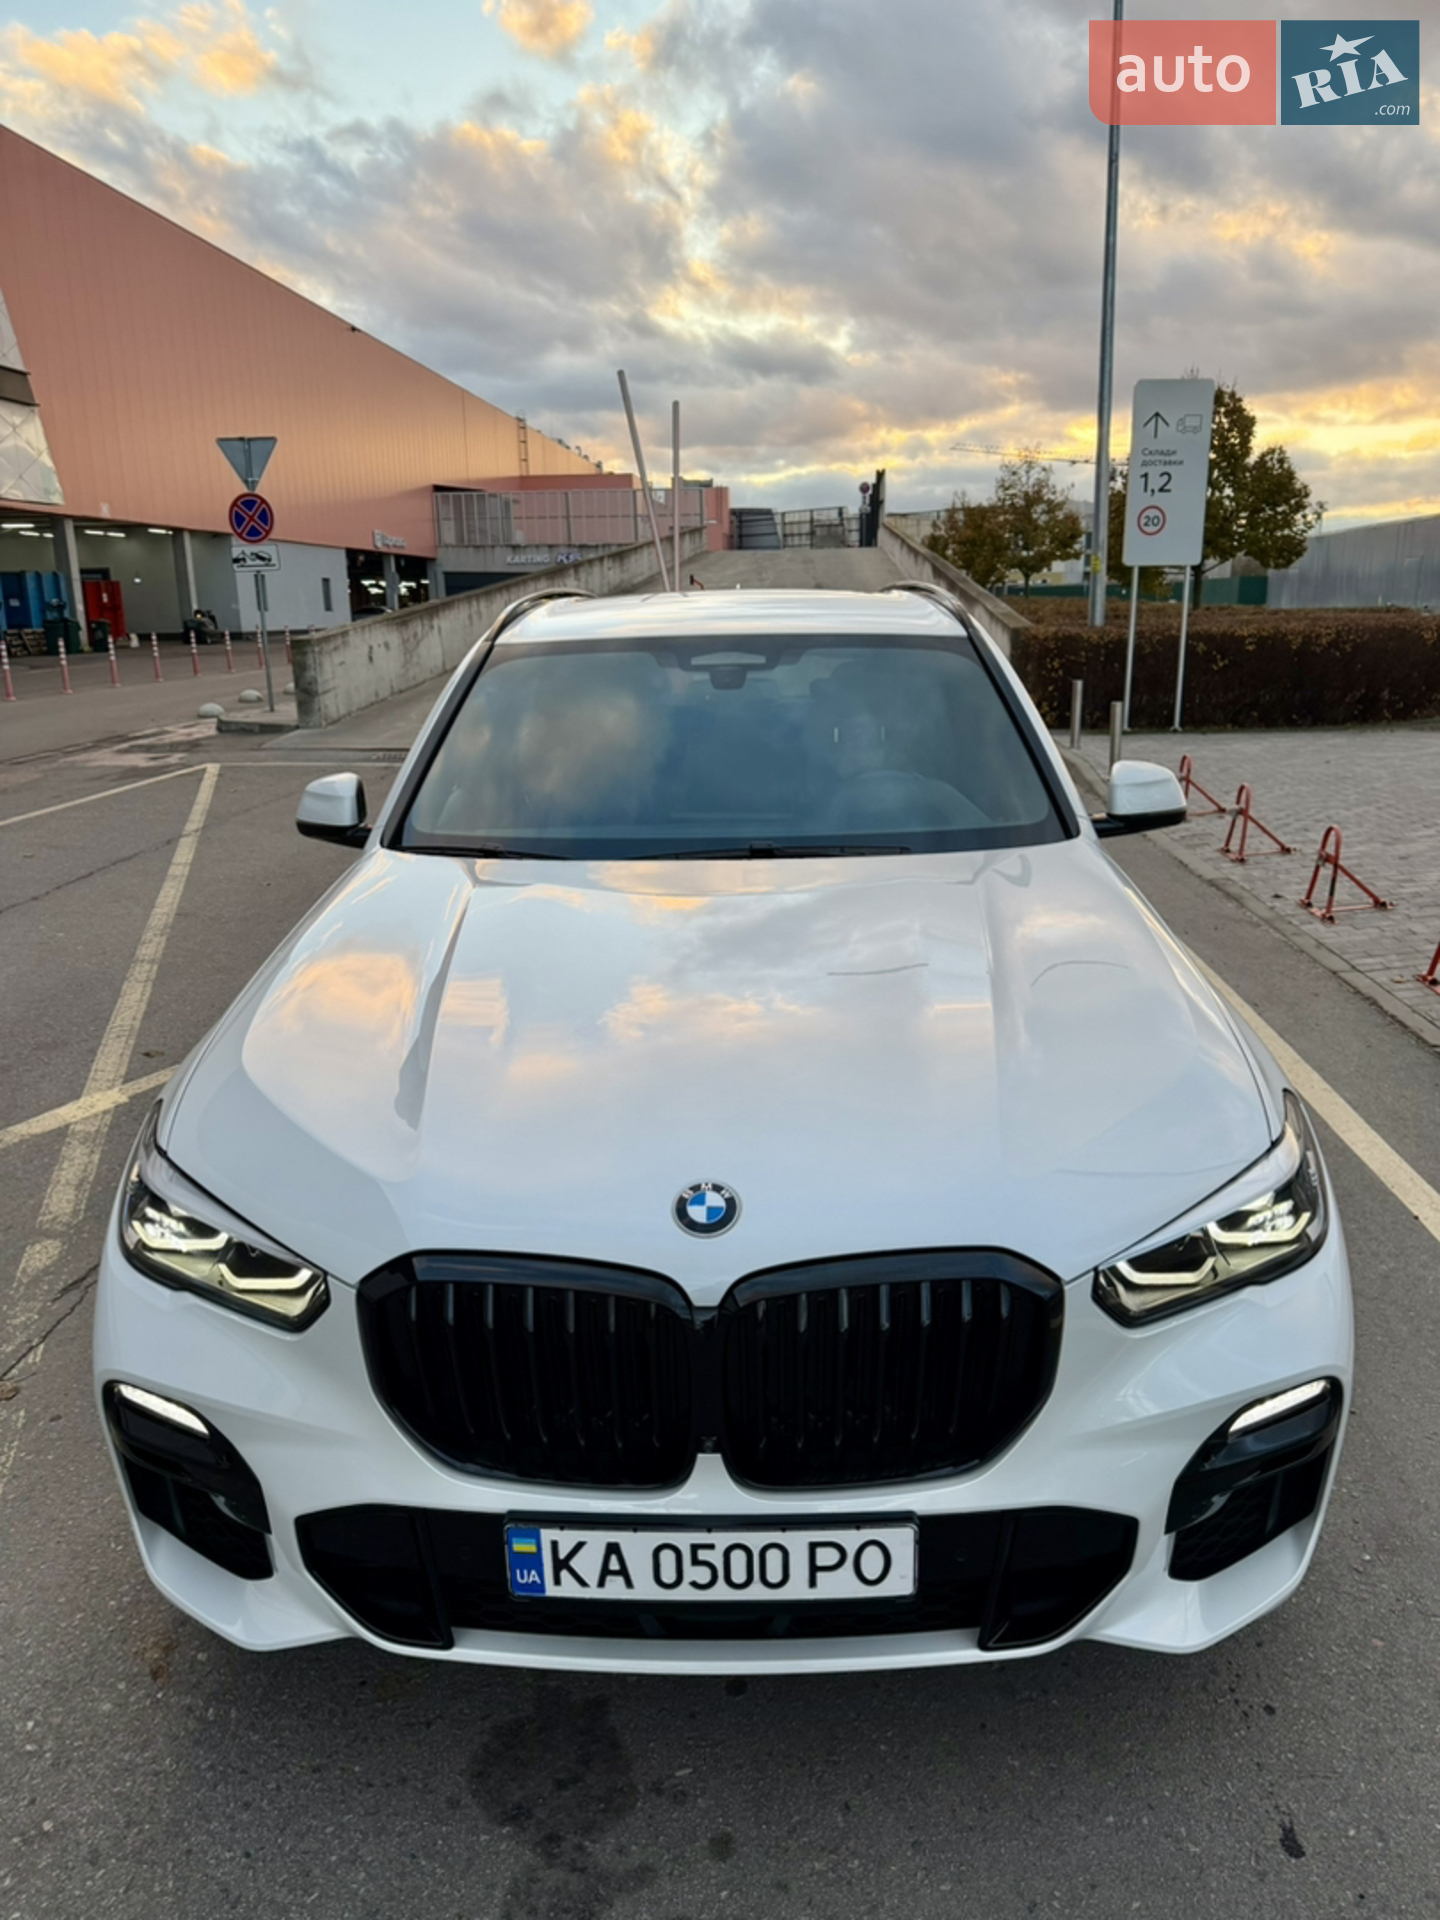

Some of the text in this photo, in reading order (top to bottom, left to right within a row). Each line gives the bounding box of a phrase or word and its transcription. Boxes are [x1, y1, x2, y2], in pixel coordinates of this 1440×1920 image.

[1141, 448, 1177, 457] Склади
[1140, 458, 1184, 467] доставки
[1139, 471, 1173, 497] 1,2
[1142, 515, 1161, 527] 20
[682, 1182, 732, 1199] BMW
[550, 1539, 892, 1590] KA 0500 PO
[516, 1569, 541, 1585] UA
